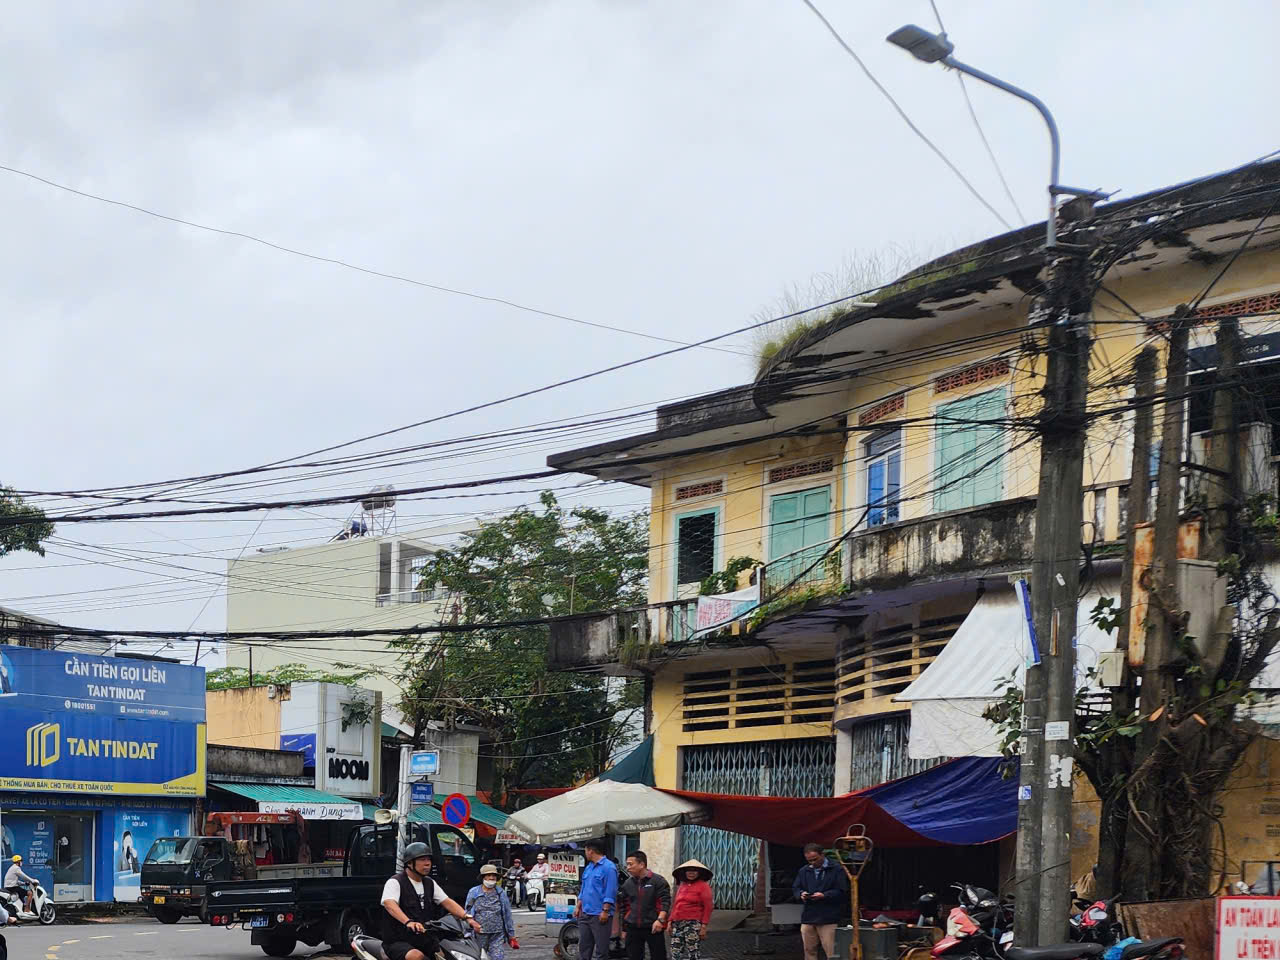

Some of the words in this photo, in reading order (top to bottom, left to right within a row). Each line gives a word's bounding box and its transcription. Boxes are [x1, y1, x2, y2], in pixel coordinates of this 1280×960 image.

[64, 656, 89, 677] CẦN
[91, 659, 118, 680] TIỀN
[120, 665, 140, 685] GỌI
[142, 665, 166, 684] LIỀN
[563, 863, 576, 873] CUA
[1224, 907, 1237, 927] AN
